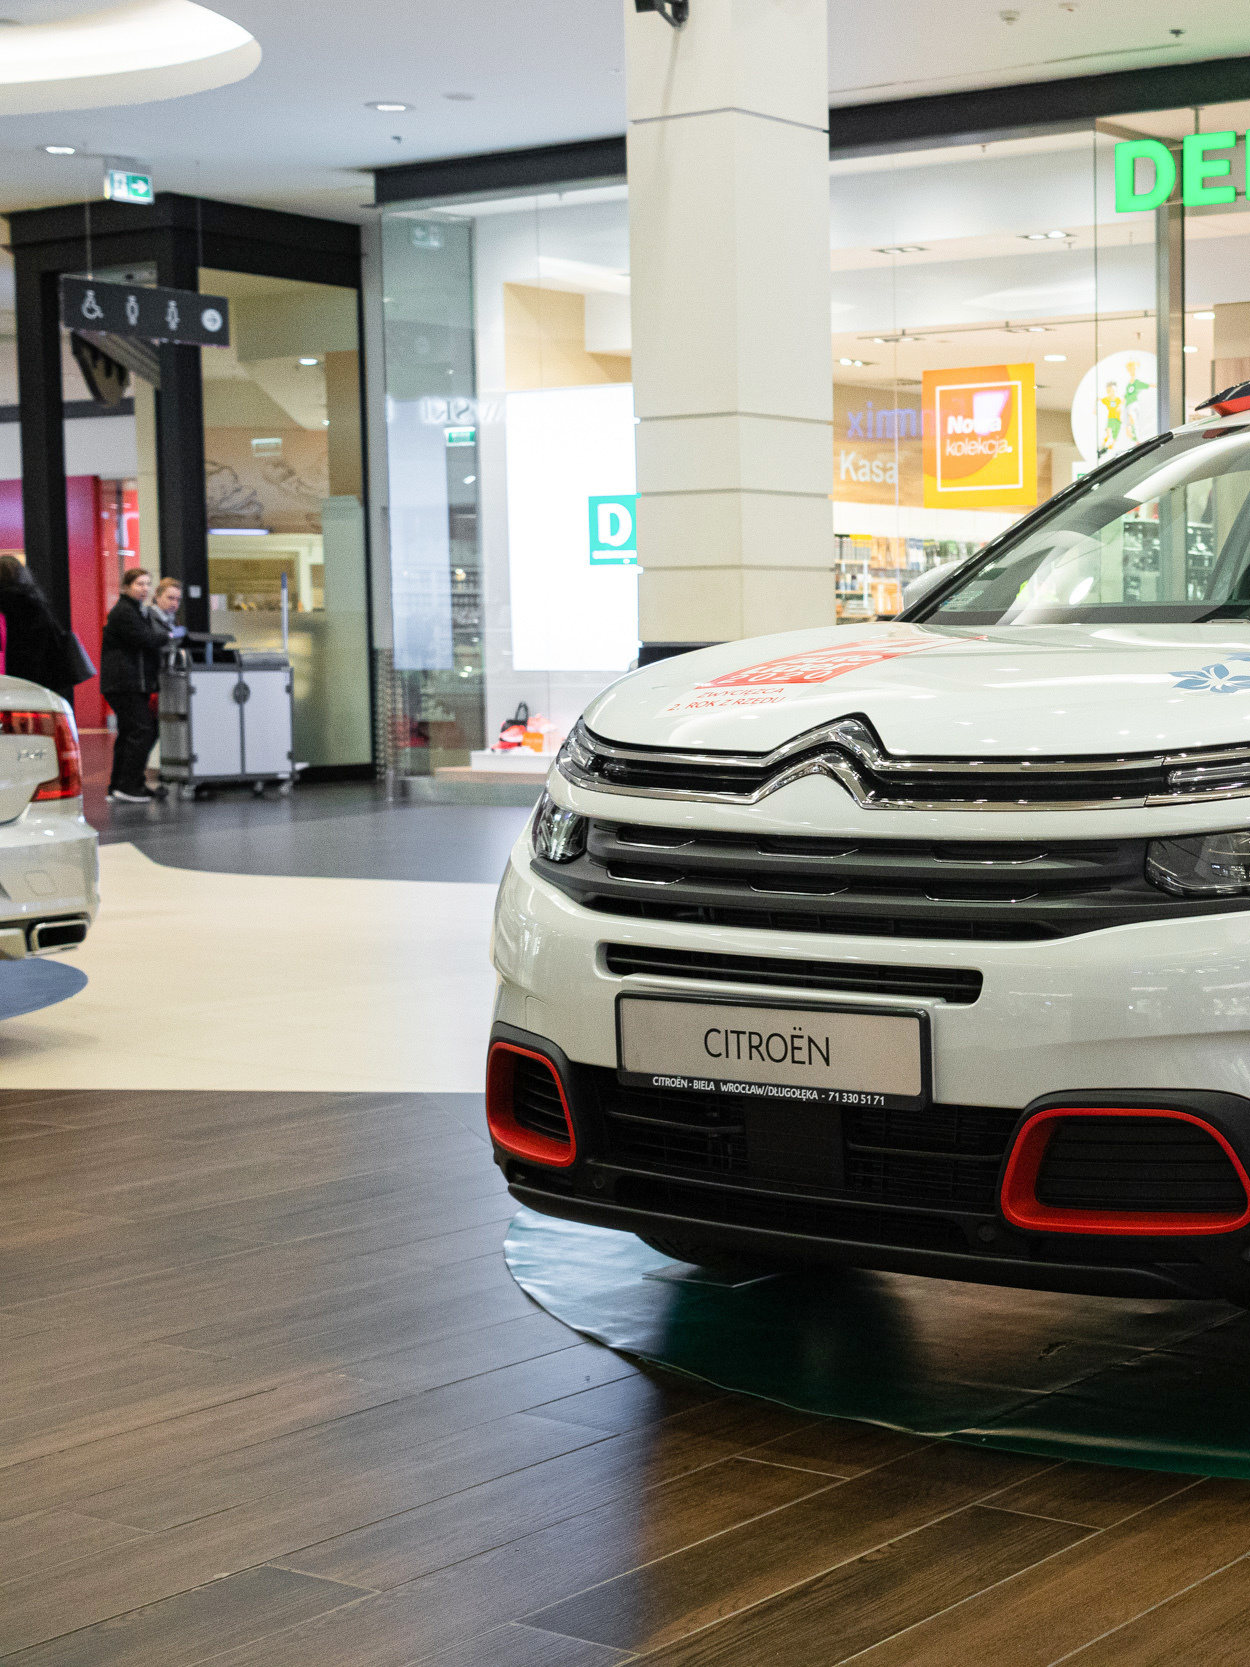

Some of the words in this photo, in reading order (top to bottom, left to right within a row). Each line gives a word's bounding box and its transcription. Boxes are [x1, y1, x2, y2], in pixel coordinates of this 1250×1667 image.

[947, 415, 1002, 434] Noa
[839, 449, 898, 484] Kasa
[716, 670, 833, 685] 2020
[684, 700, 718, 710] ROK
[703, 1026, 831, 1067] CITROËN
[652, 1075, 688, 1089] CITROËN
[693, 1079, 716, 1091] BIELA
[828, 1091, 840, 1102] 71
[841, 1093, 859, 1103] 330
